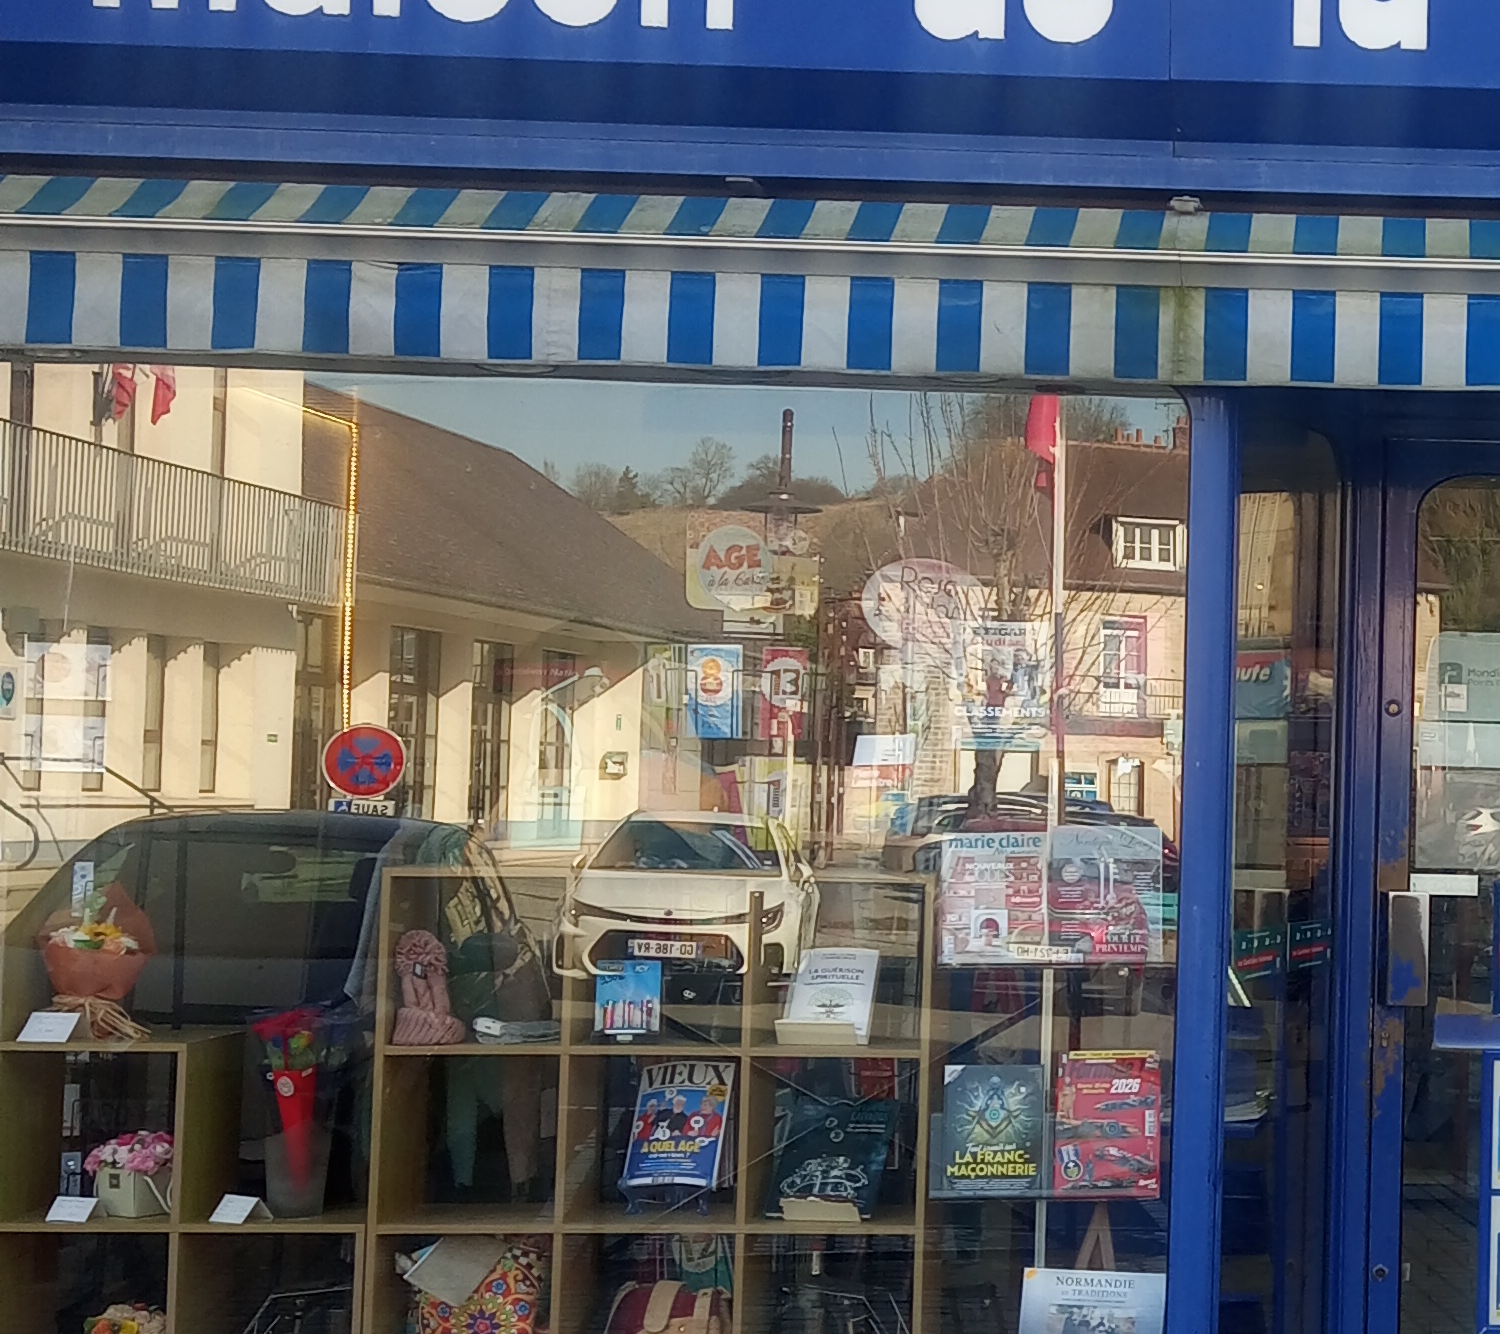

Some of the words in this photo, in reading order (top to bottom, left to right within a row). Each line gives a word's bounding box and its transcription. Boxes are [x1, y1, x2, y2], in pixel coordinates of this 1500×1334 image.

[953, 706, 1046, 718] CLASSEMENTS
[948, 834, 995, 850] marie
[999, 834, 1042, 849] claire
[645, 1063, 732, 1089] VIEUX
[1109, 1078, 1142, 1094] 2026
[955, 1151, 973, 1163] LA
[977, 1149, 1031, 1163] FRANC-
[946, 1163, 1038, 1179] MAÇONNERIE
[1055, 1276, 1136, 1289] NORMANDIE
[1072, 1289, 1129, 1299] TRADITIONS
